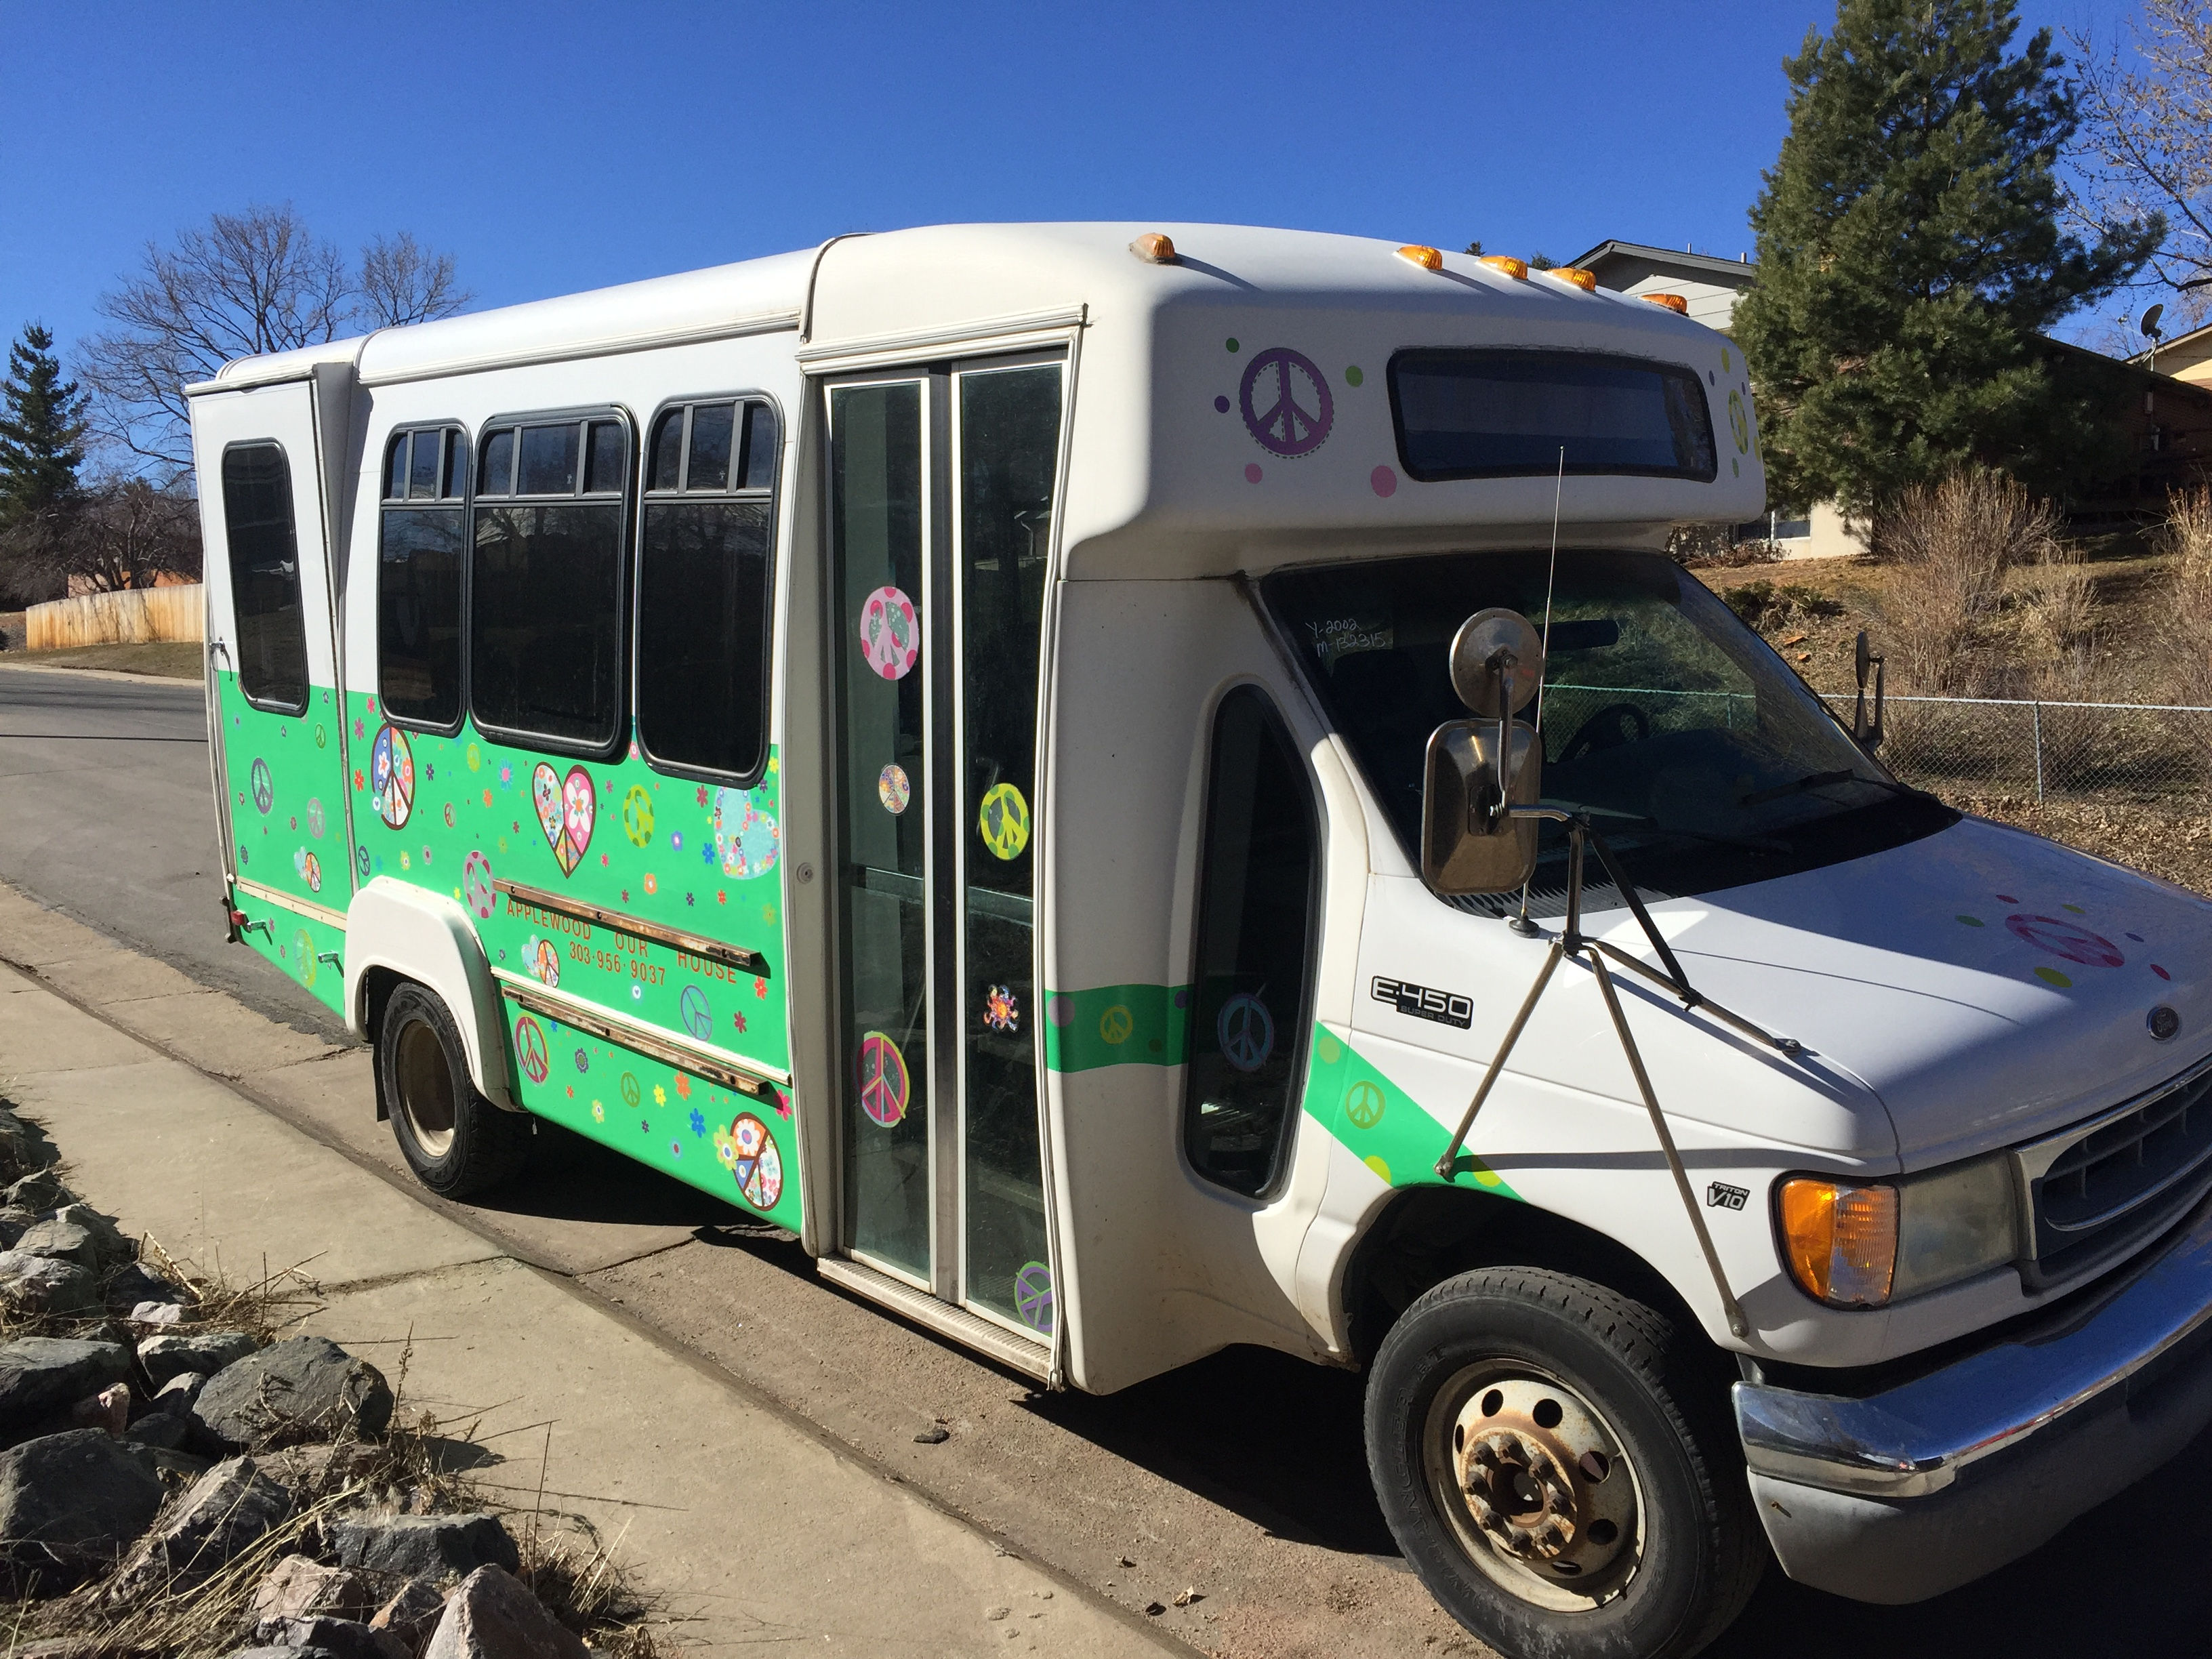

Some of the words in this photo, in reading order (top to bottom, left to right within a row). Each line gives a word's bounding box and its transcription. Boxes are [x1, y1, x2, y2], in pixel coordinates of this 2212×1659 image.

[506, 898, 592, 941] APPLEWOOD
[614, 930, 649, 958] OUR
[677, 947, 737, 985] HOUSE
[1400, 1004, 1435, 1019] SUPER
[1437, 1014, 1466, 1027] DUTY
[1708, 1187, 1744, 1210] V10
[1713, 1183, 1748, 1196] TRITON
